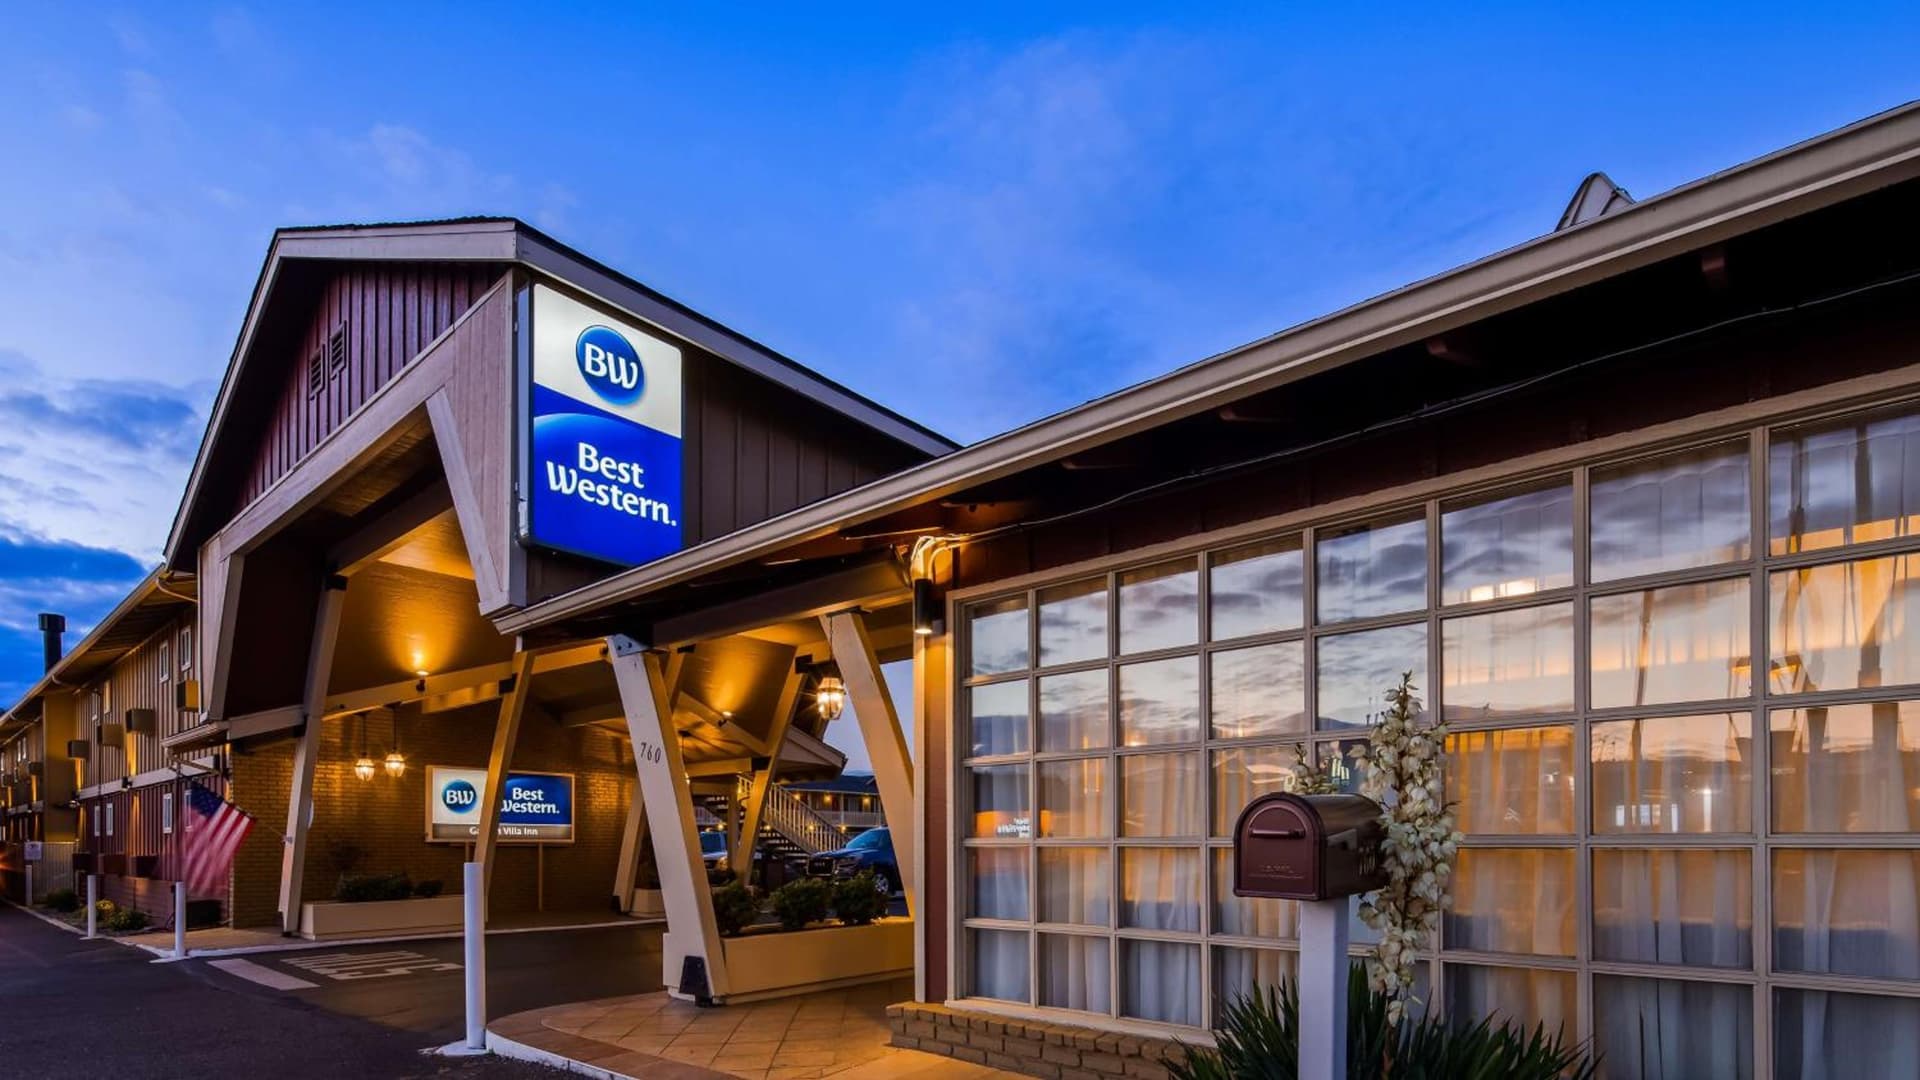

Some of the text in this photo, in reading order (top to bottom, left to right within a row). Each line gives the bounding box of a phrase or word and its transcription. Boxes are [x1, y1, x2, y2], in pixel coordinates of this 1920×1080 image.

[583, 341, 639, 390] BW
[577, 442, 645, 489] Best
[546, 460, 678, 527] Western.
[640, 741, 662, 764] 760
[446, 790, 474, 805] BW
[512, 787, 544, 800] Best
[502, 826, 522, 836] Villa
[524, 826, 538, 836] Inn
